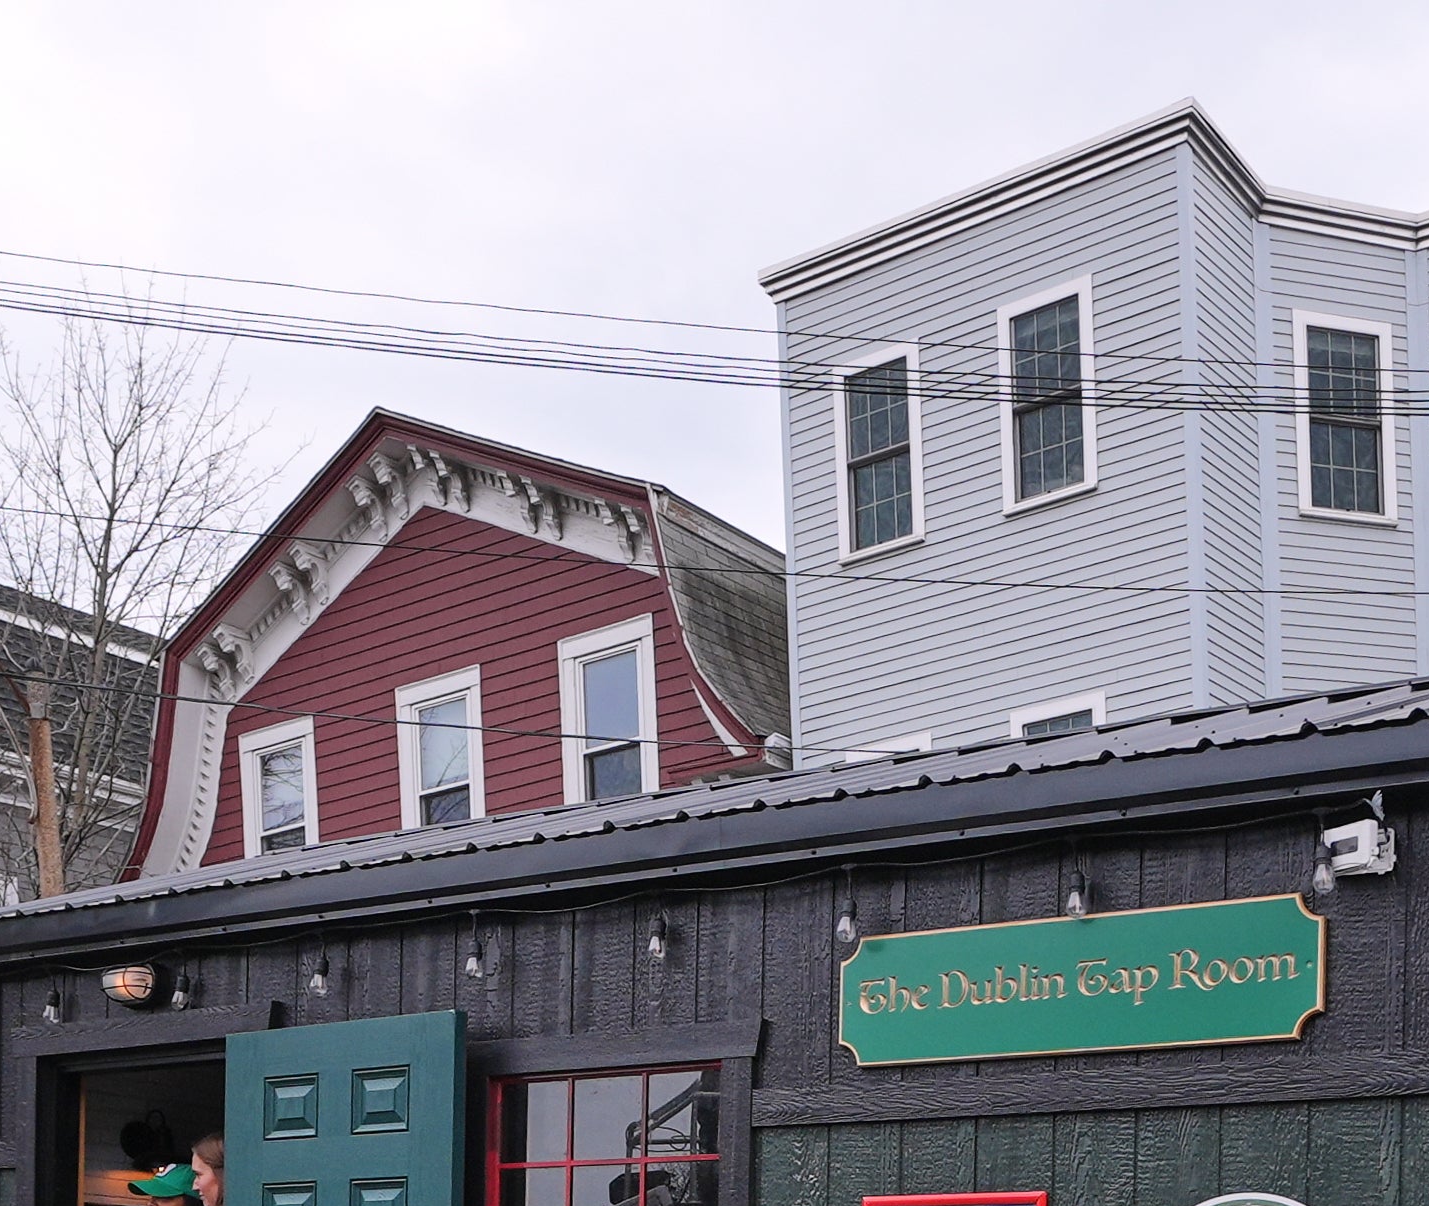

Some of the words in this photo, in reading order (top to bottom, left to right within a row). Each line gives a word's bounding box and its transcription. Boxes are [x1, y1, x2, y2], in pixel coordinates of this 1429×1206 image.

[859, 978, 931, 1015] The
[937, 963, 1066, 1009] Dublin
[1076, 957, 1160, 1005] Tap
[1167, 949, 1300, 991] Room
